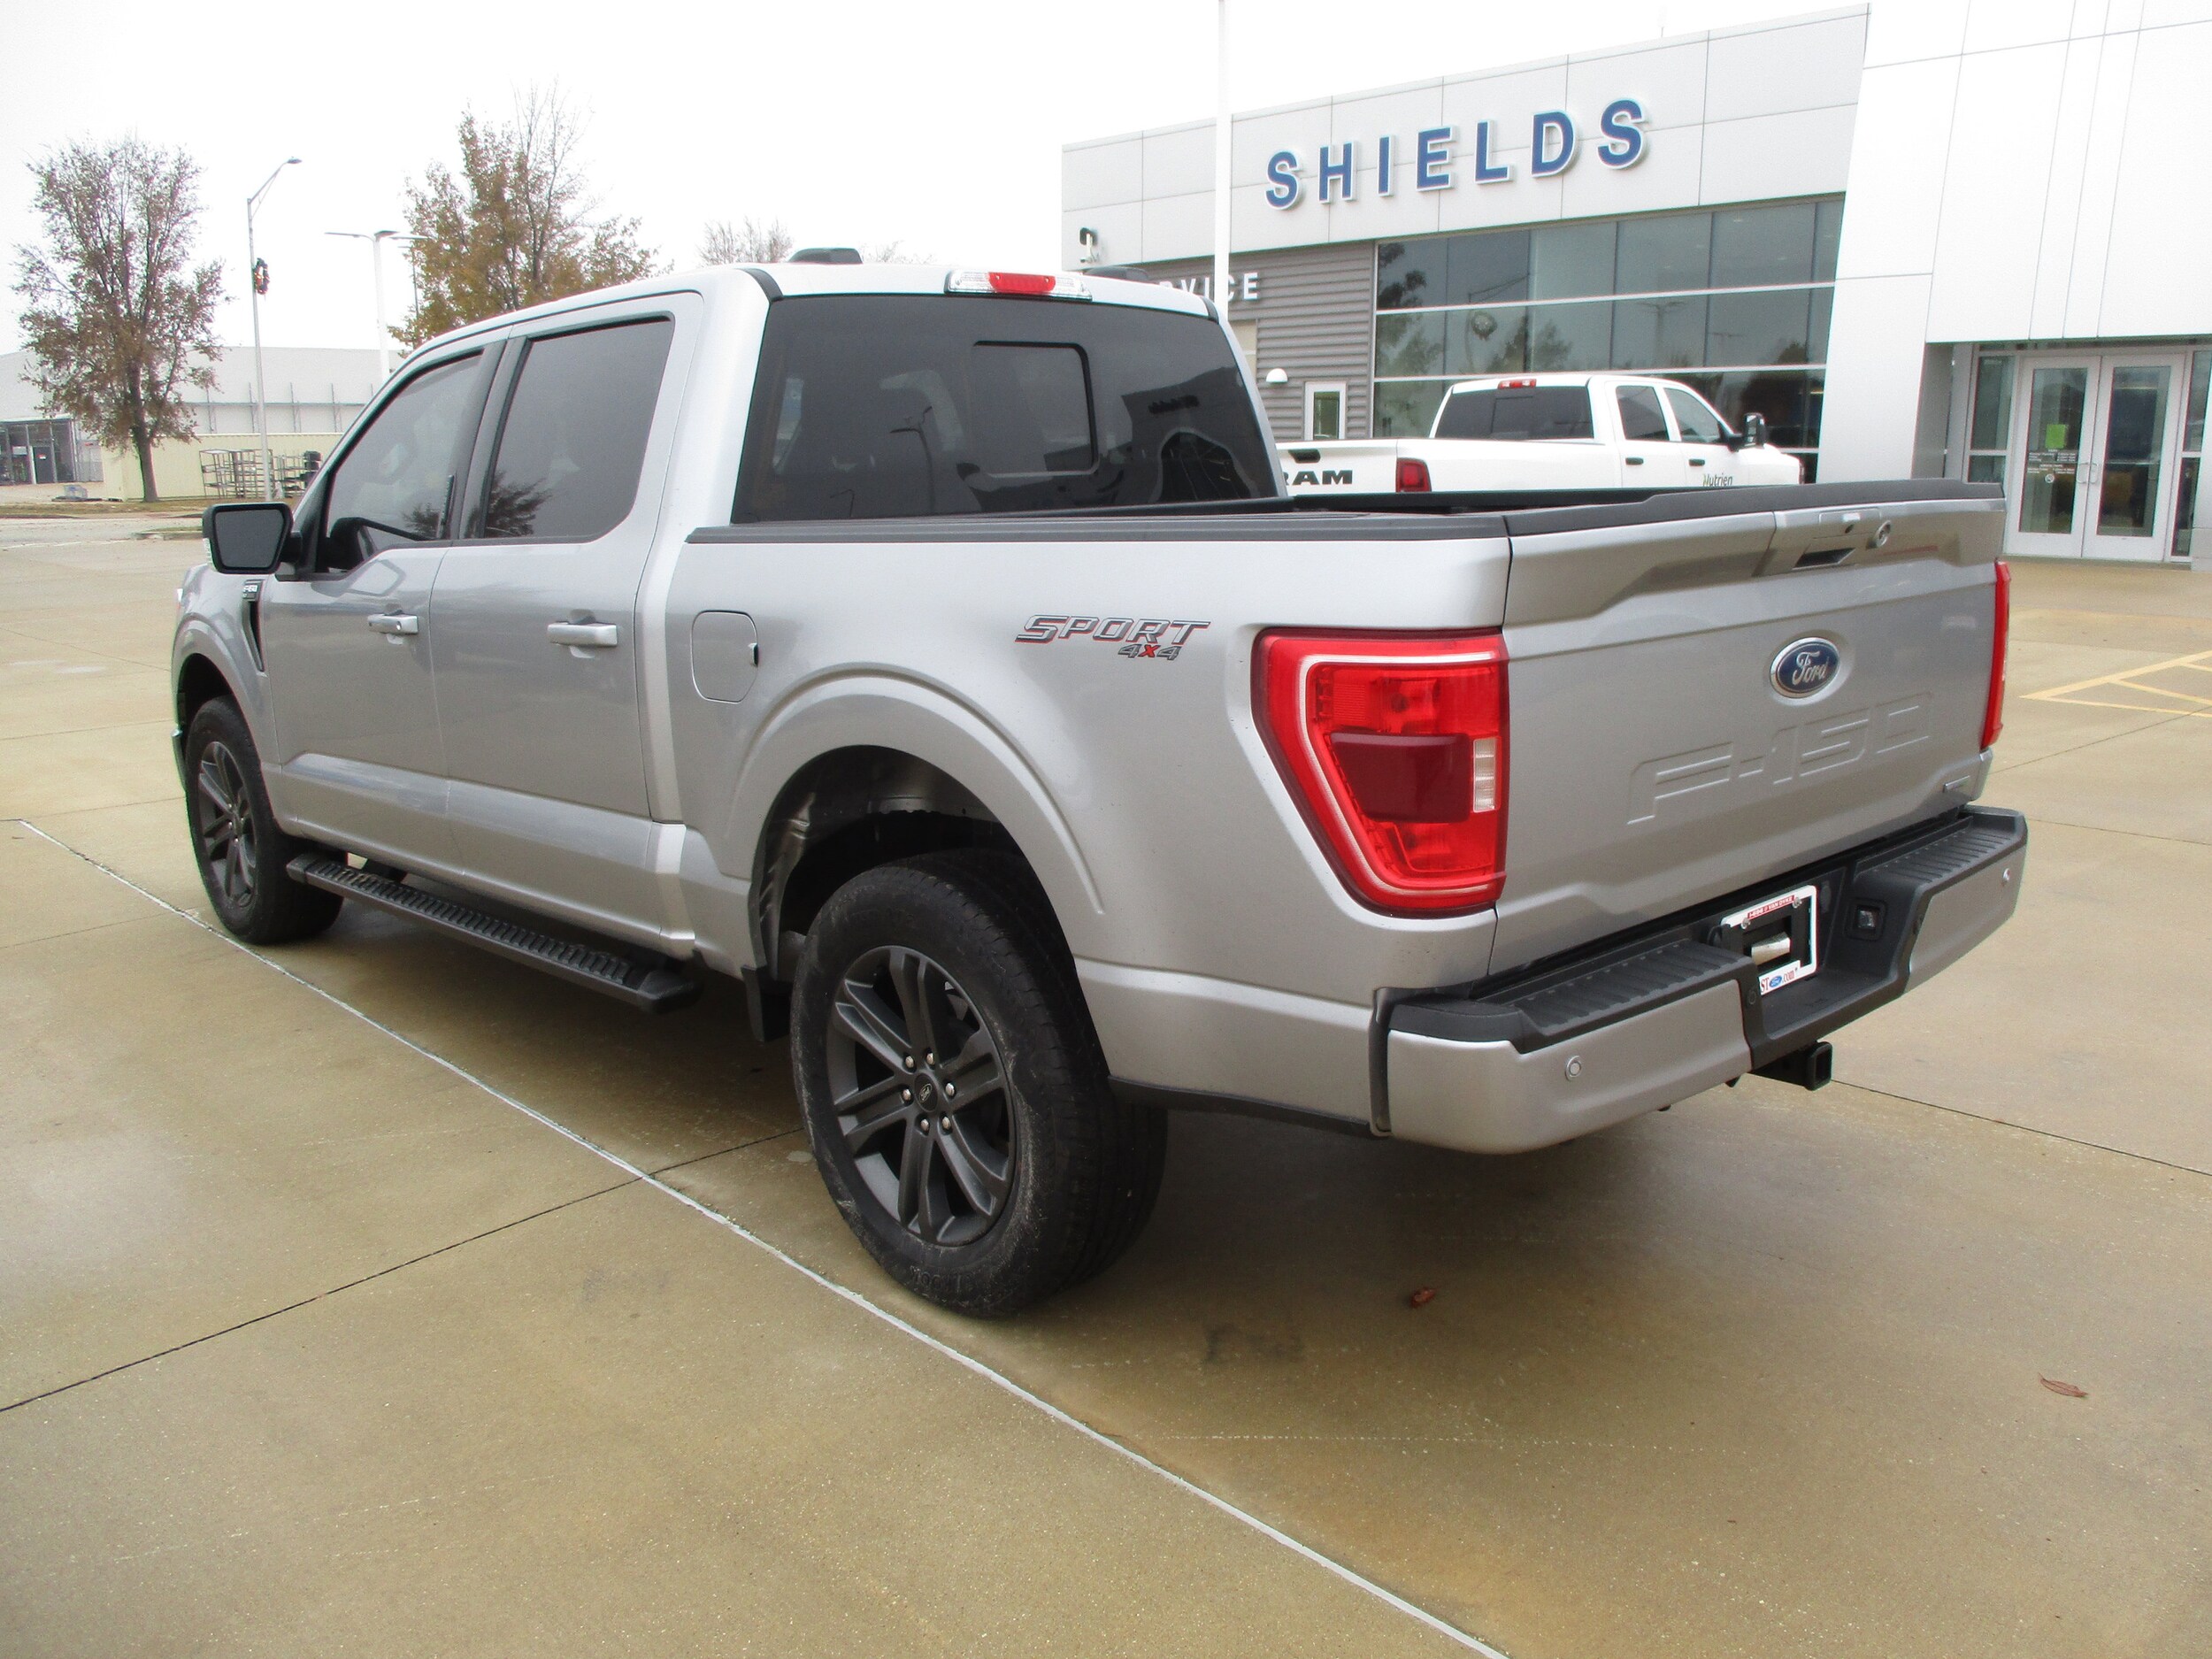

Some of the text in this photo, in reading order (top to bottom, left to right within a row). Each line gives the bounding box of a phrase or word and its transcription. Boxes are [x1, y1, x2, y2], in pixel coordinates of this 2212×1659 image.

[1265, 98, 1646, 211] SHIELDS
[1702, 472, 1733, 487] Nutrien
[1014, 614, 1211, 646] SPORT
[1792, 650, 1830, 686] Ford
[1626, 692, 1934, 825] F-150
